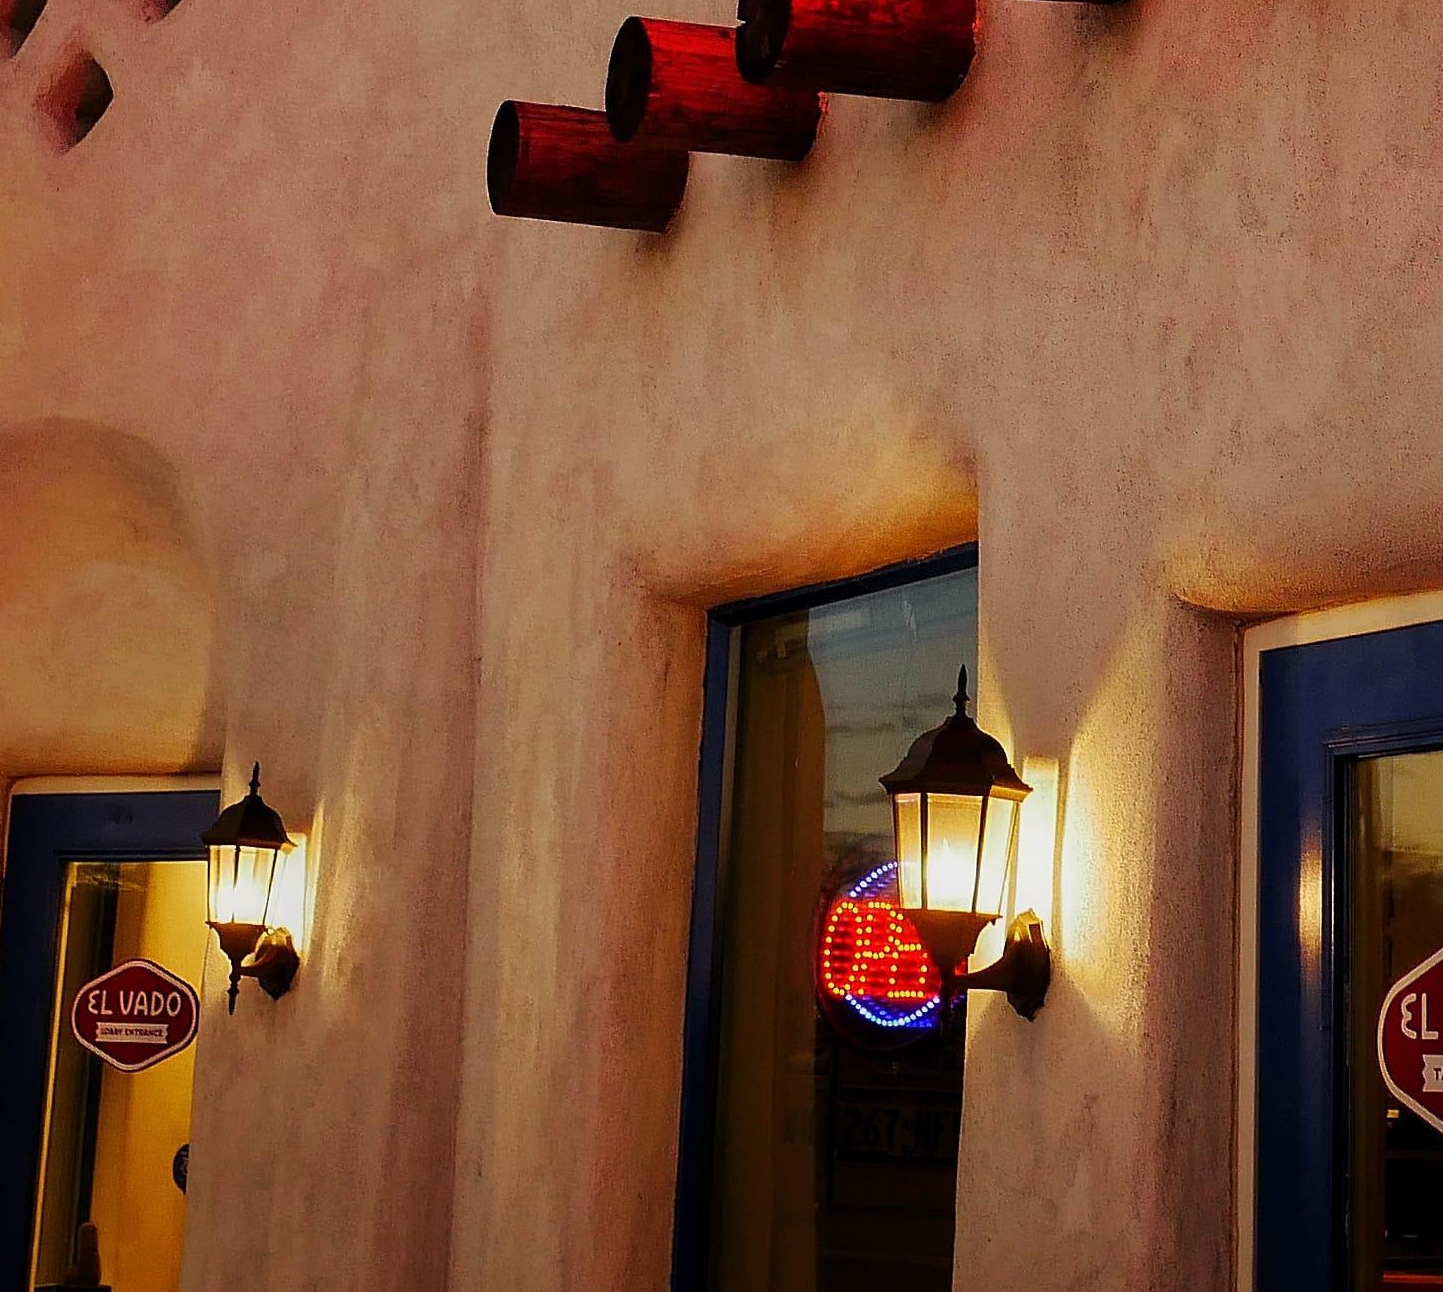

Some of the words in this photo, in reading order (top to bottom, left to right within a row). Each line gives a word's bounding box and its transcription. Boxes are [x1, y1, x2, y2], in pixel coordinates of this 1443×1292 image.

[87, 989, 113, 1015] EL
[119, 990, 182, 1017] VADO
[1400, 992, 1439, 1040] EL
